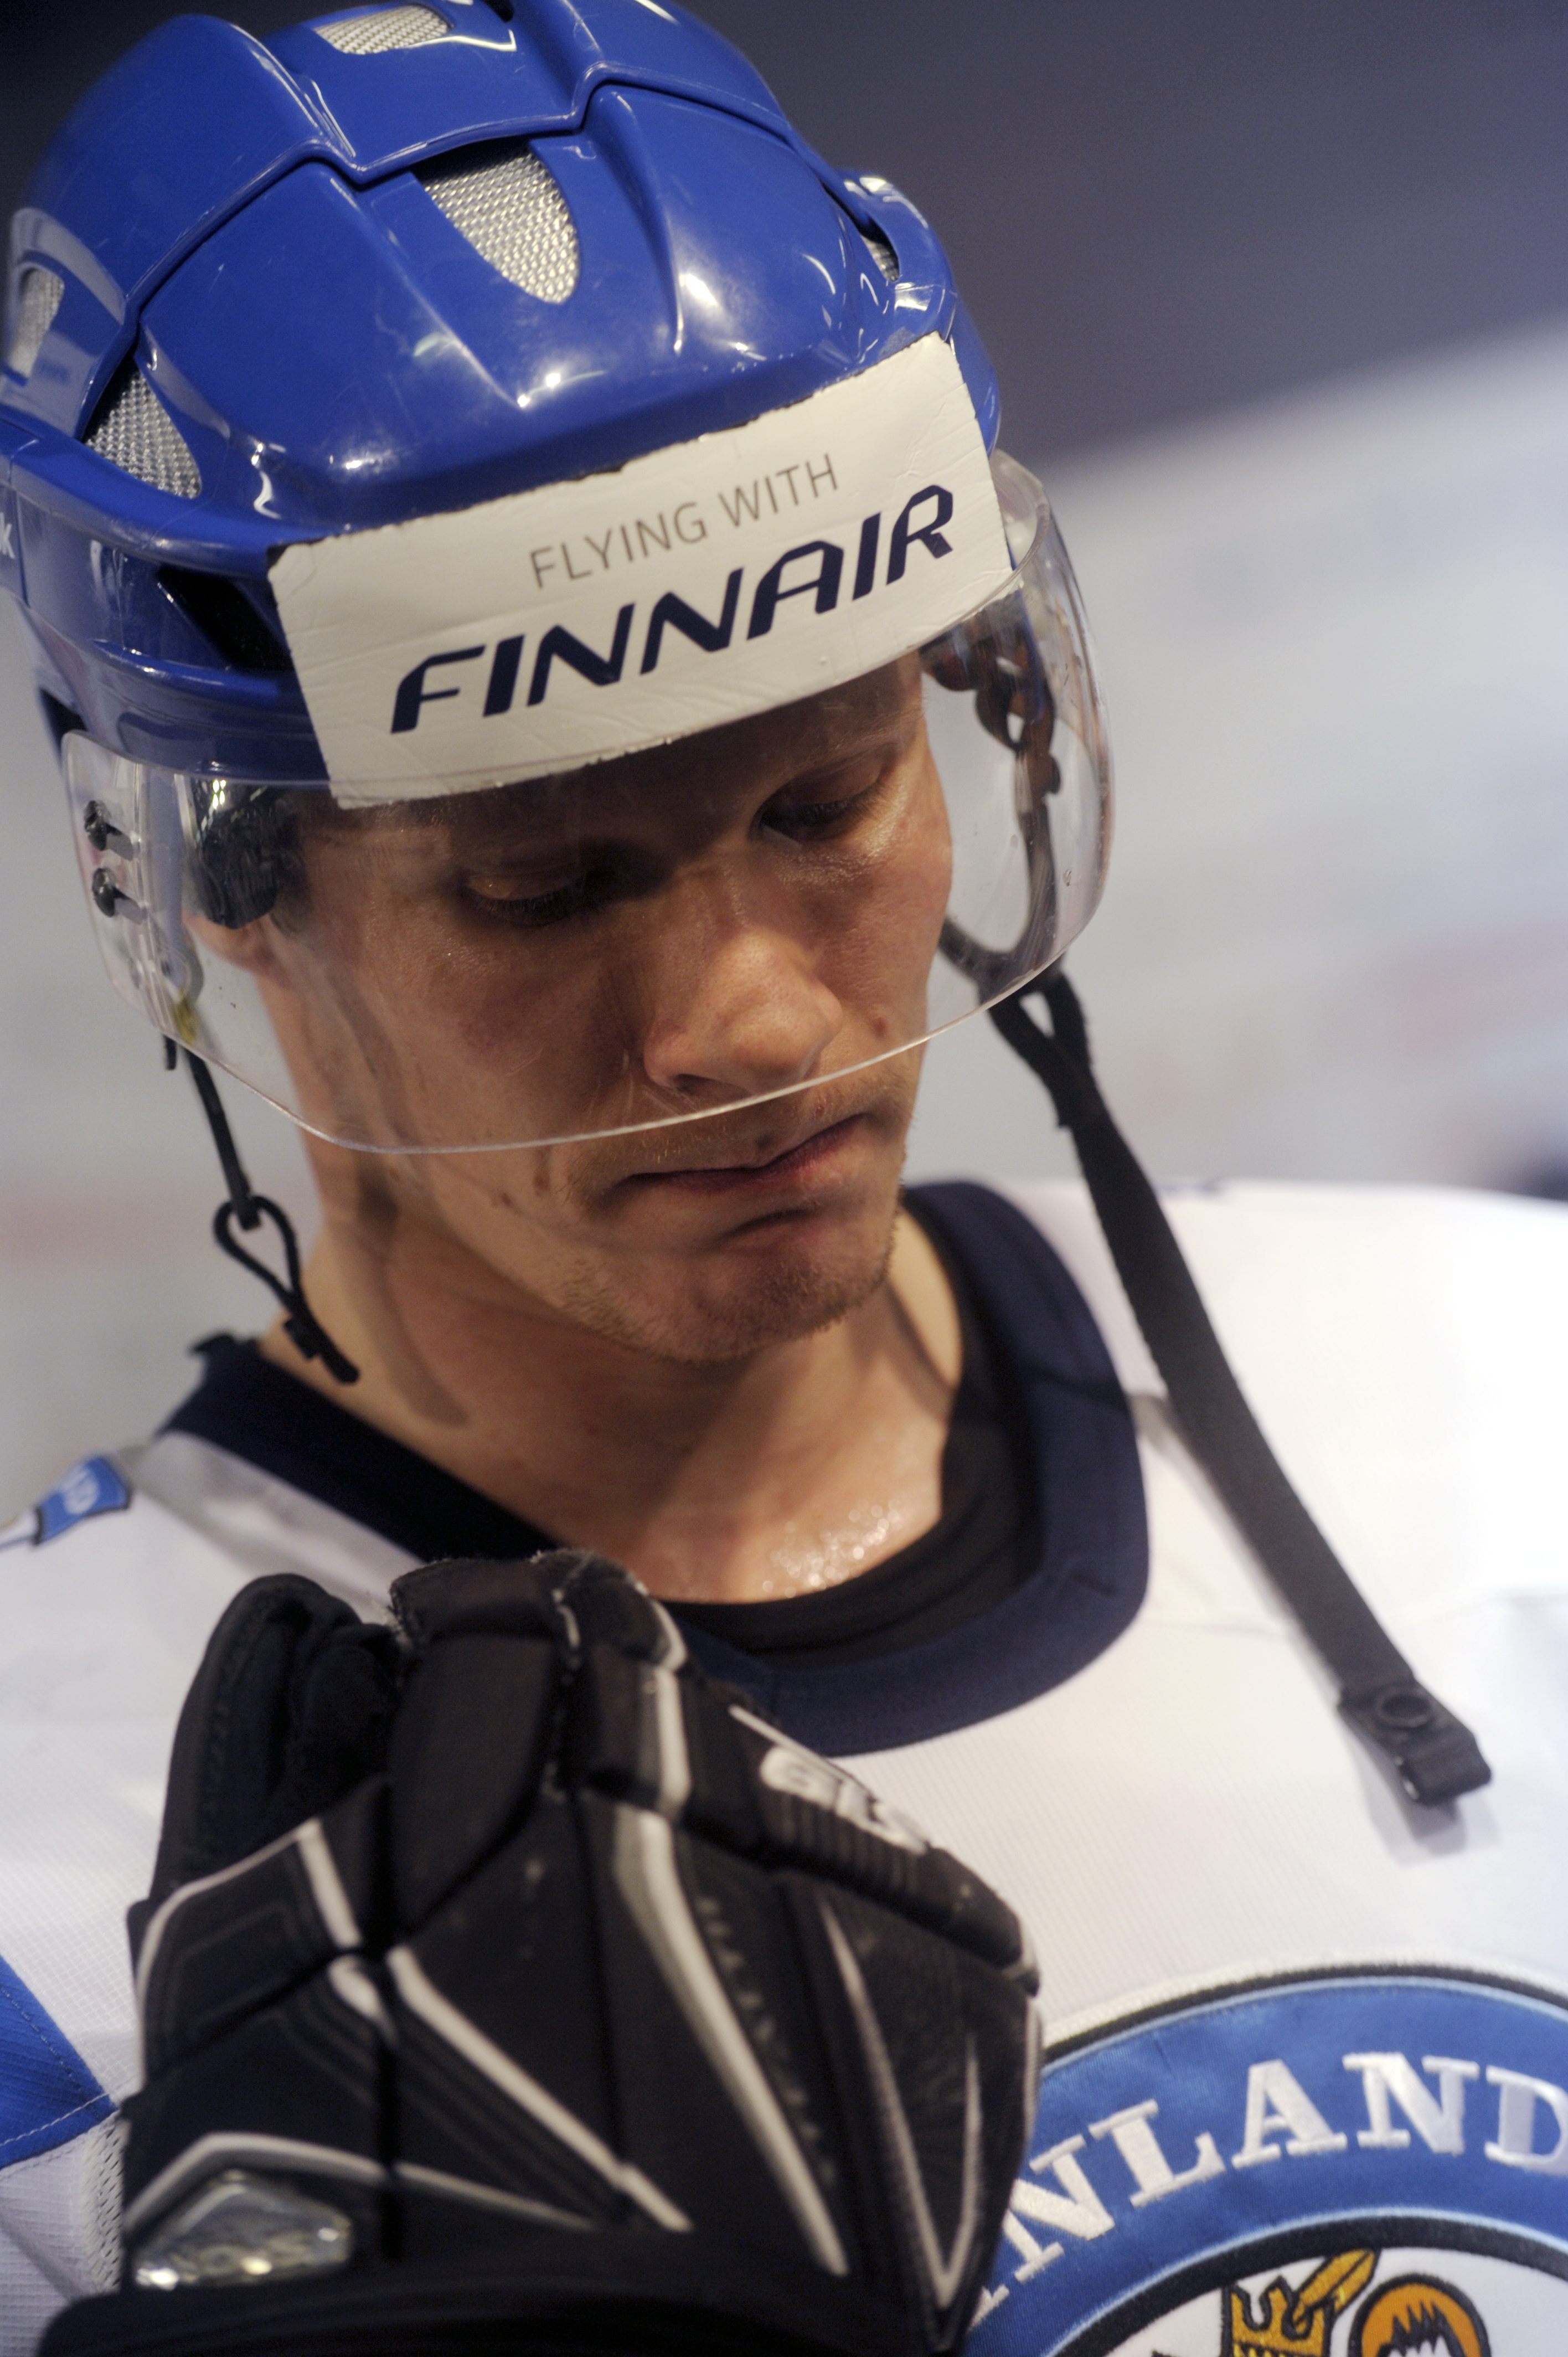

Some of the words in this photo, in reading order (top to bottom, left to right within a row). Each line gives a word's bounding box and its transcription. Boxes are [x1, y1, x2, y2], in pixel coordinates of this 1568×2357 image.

[389, 483, 955, 735] FINNAIR
[529, 502, 707, 589] FLYING
[719, 454, 838, 528] WITH
[970, 2051, 1568, 2328] NLAND
